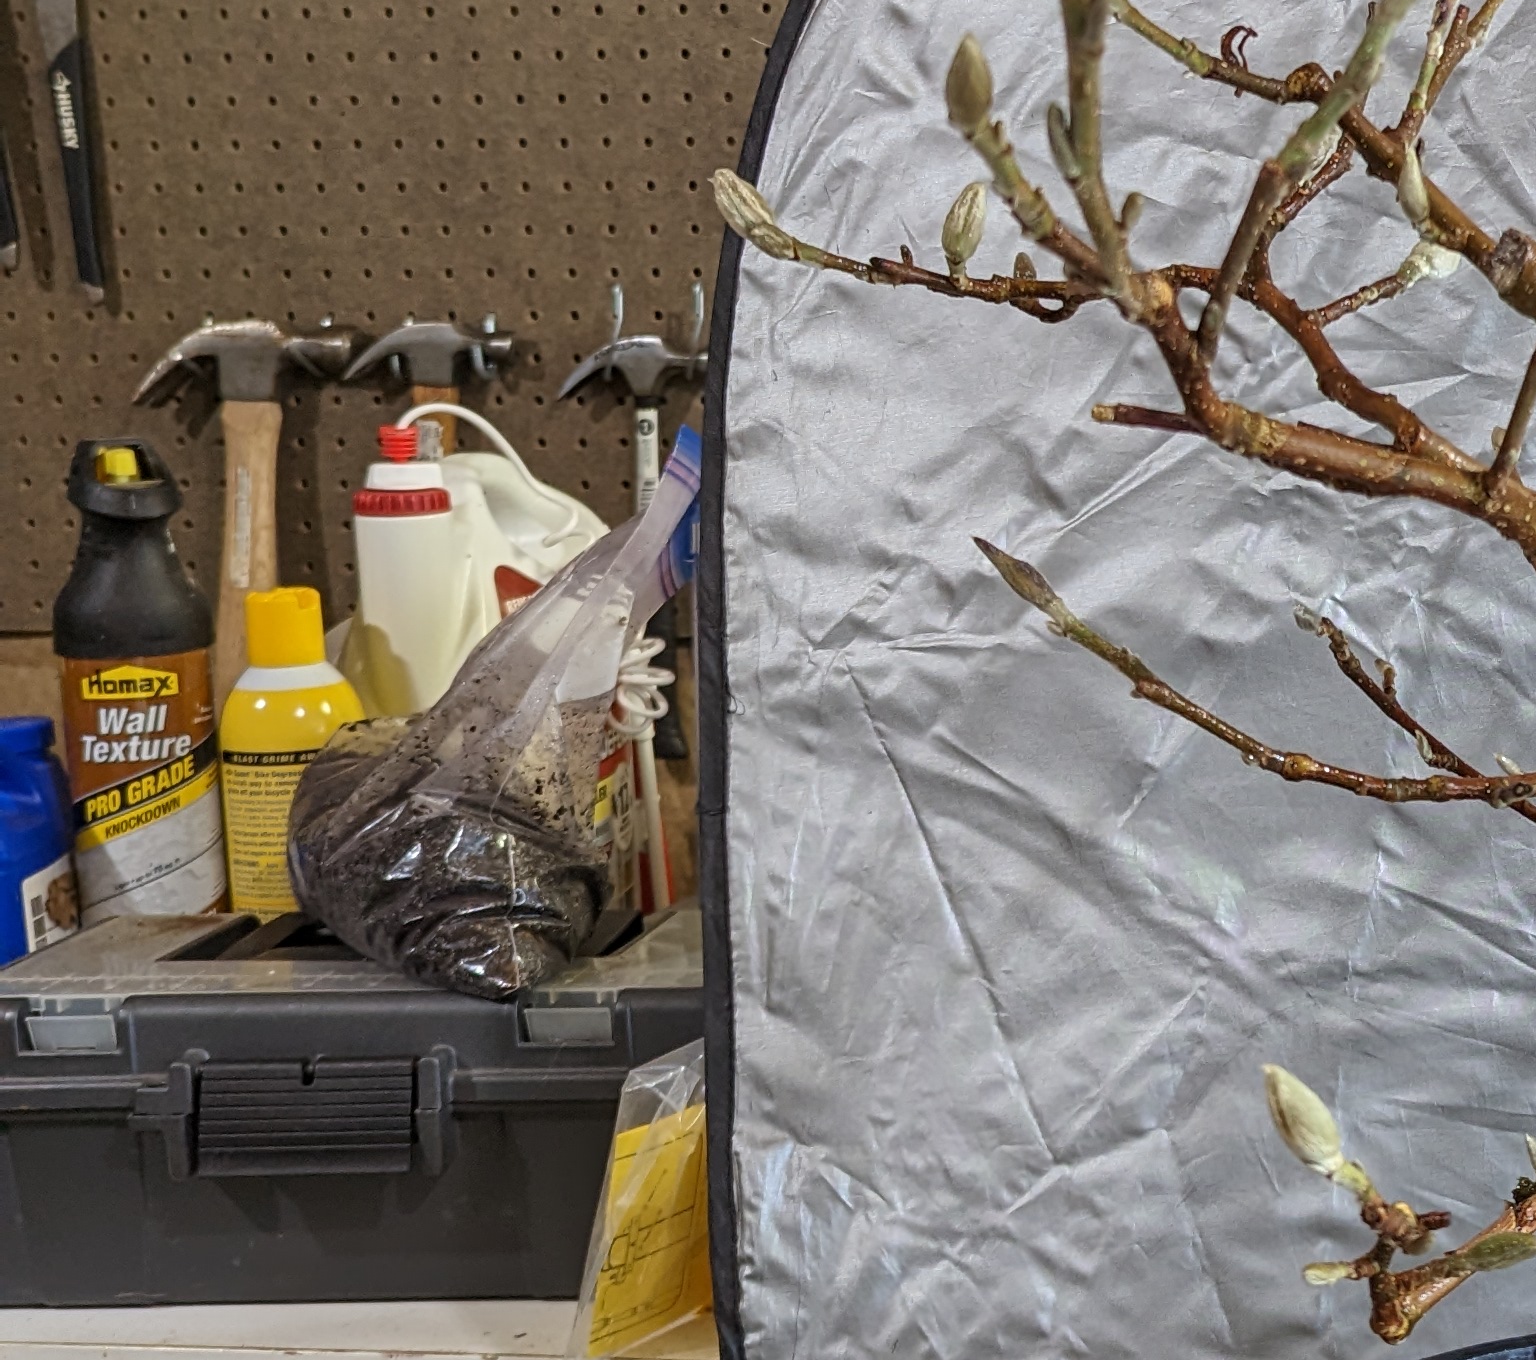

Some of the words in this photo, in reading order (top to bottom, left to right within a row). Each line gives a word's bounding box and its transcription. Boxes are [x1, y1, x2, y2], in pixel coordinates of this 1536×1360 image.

[56, 93, 79, 149] HUSKY
[99, 706, 168, 735] Wall
[81, 734, 192, 763] Texture
[85, 790, 122, 822] PRO
[127, 754, 195, 804] GRADE
[105, 795, 182, 839] KNOCKDOWN
